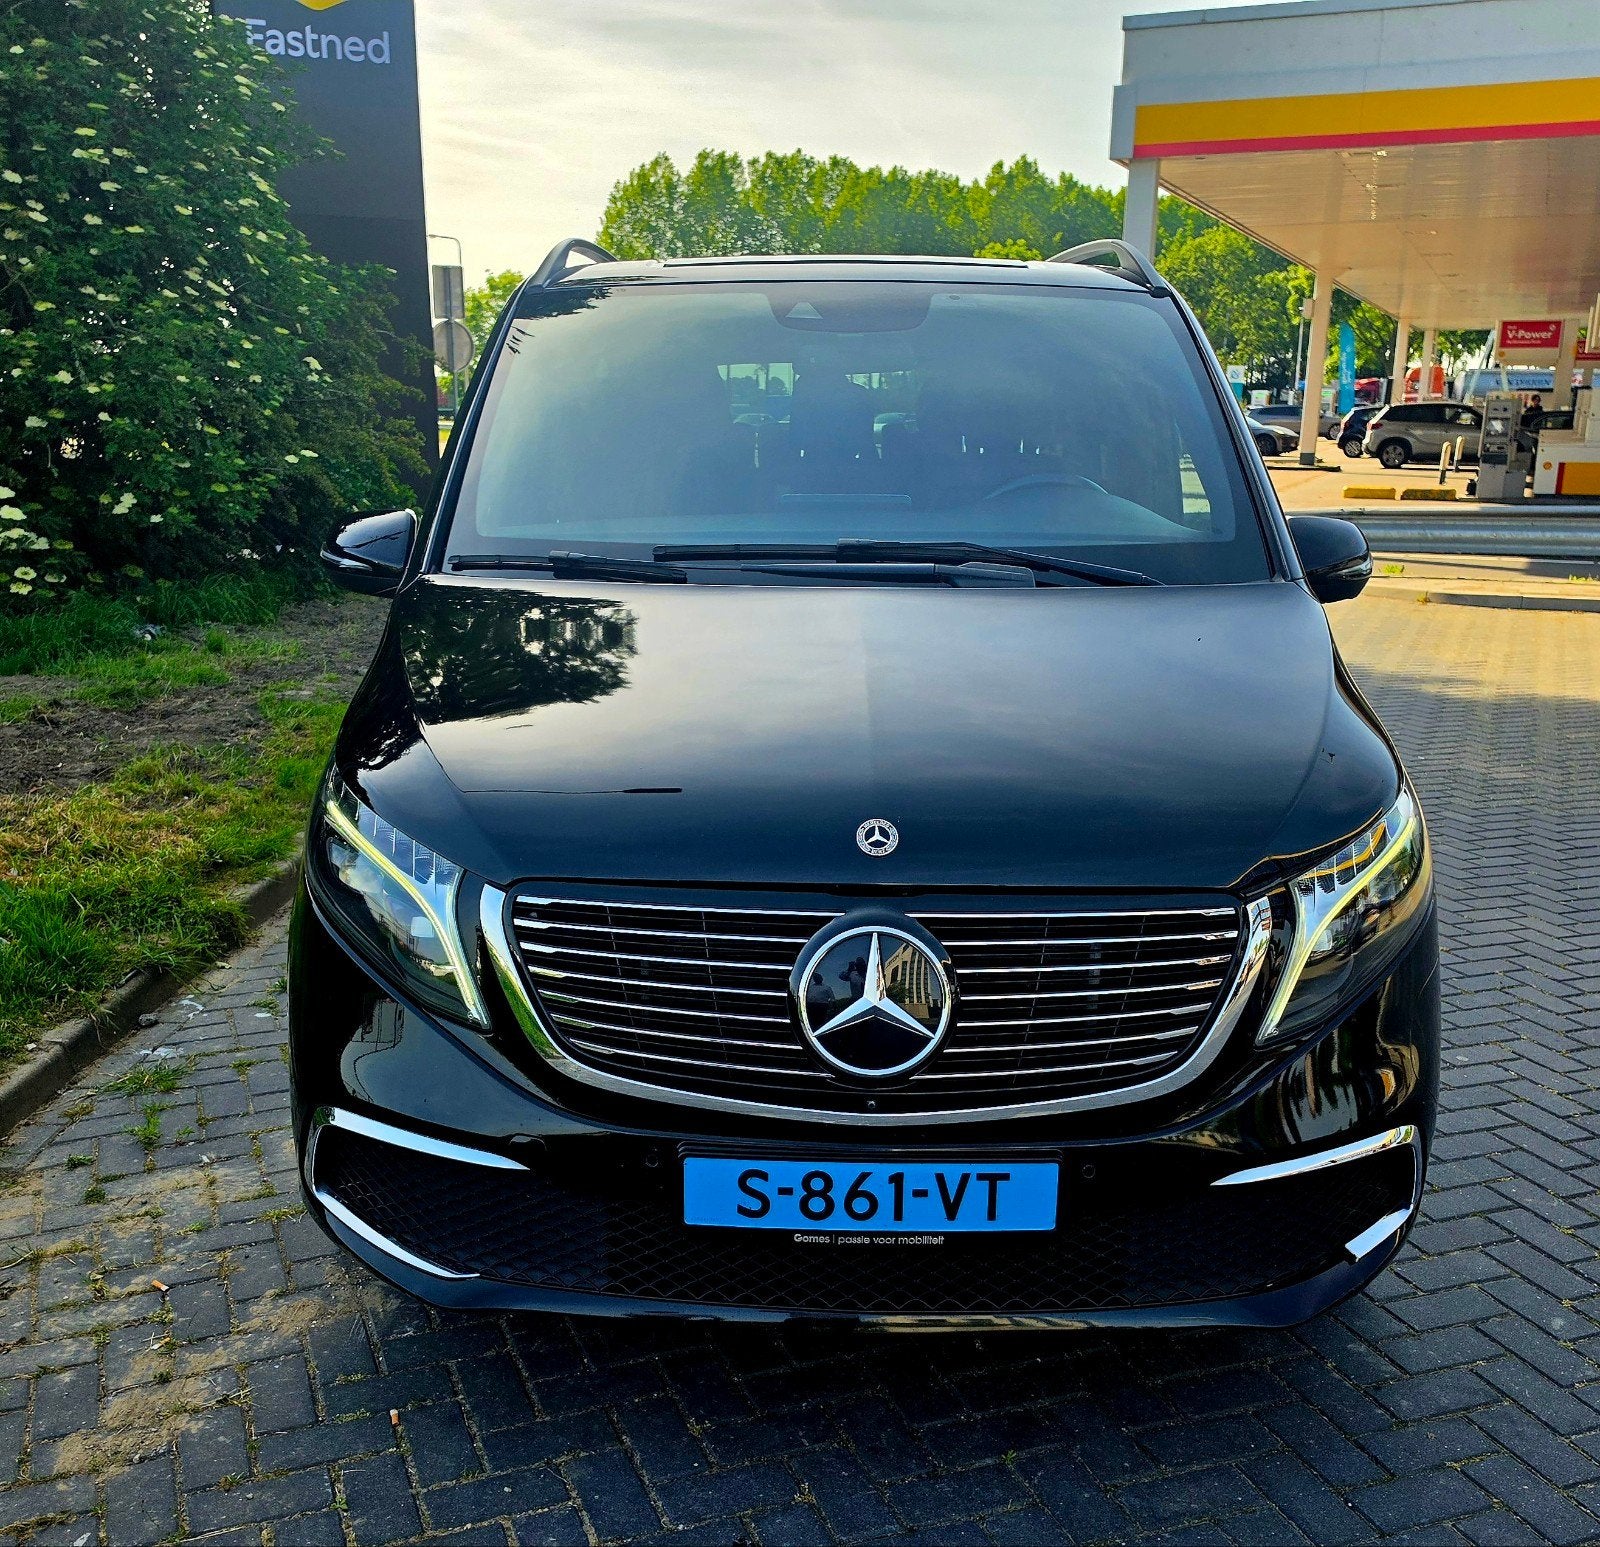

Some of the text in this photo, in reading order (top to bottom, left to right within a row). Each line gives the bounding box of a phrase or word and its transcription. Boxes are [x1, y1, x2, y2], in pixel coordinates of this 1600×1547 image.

[245, 18, 391, 64] Fastned
[1506, 330, 1552, 339] V-Power
[736, 1168, 1011, 1222] S-861-VT
[793, 1233, 830, 1243] Gomes
[837, 1235, 870, 1245] passie
[897, 1235, 945, 1245] mobiliteit
